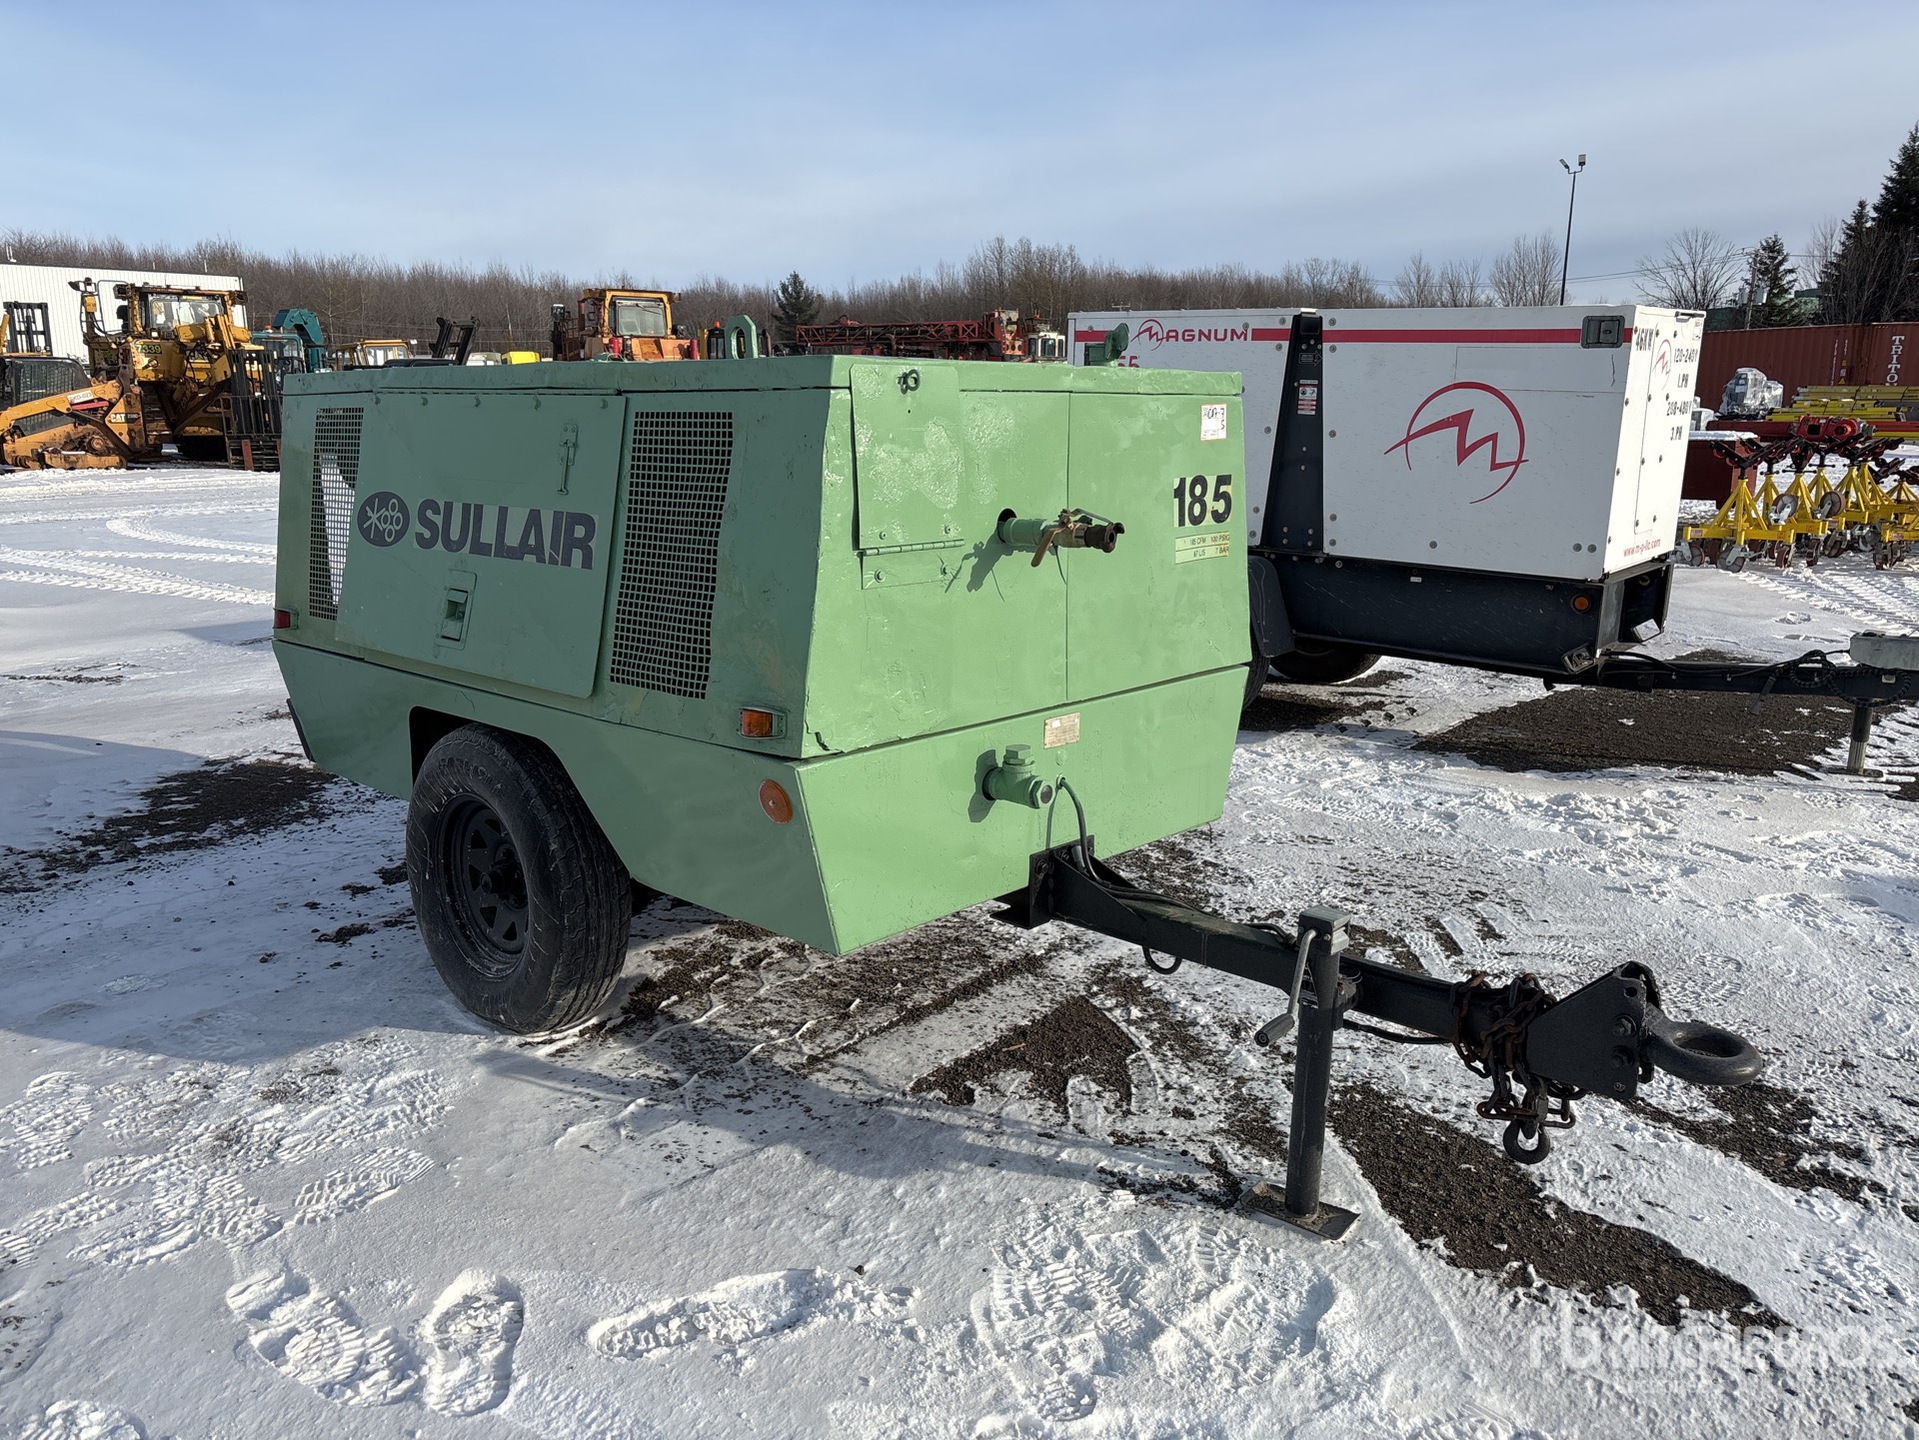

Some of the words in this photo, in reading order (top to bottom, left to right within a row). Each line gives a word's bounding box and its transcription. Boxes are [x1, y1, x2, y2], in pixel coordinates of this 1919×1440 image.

[135, 344, 162, 354] 7339
[1131, 322, 1248, 346] MAGNUM
[1884, 335, 1905, 386] TRITO
[110, 413, 126, 423] CAT
[1173, 474, 1232, 527] 185
[415, 498, 594, 570] SULLAIR
